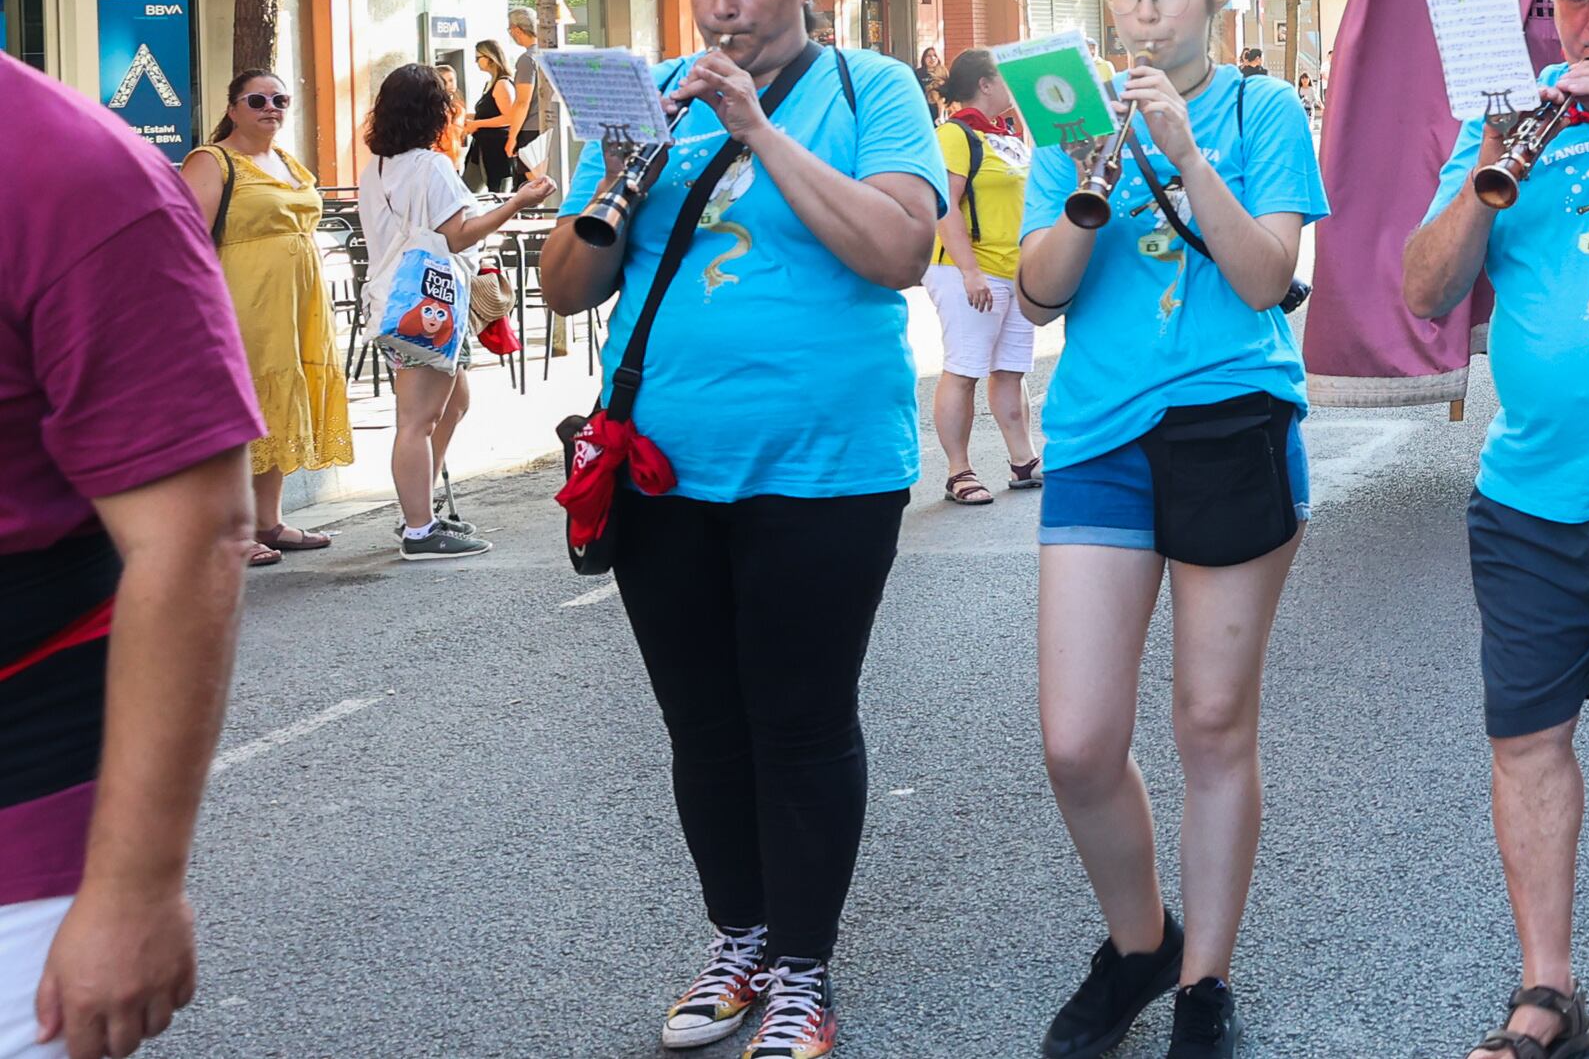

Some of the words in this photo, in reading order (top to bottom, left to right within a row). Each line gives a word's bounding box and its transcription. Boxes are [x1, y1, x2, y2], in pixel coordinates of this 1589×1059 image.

[145, 4, 183, 16] BBVA
[436, 20, 460, 34] BBVA
[144, 124, 175, 134] Estalvi
[156, 134, 182, 143] BBVA
[427, 269, 456, 290] Font
[425, 281, 453, 303] Vella
